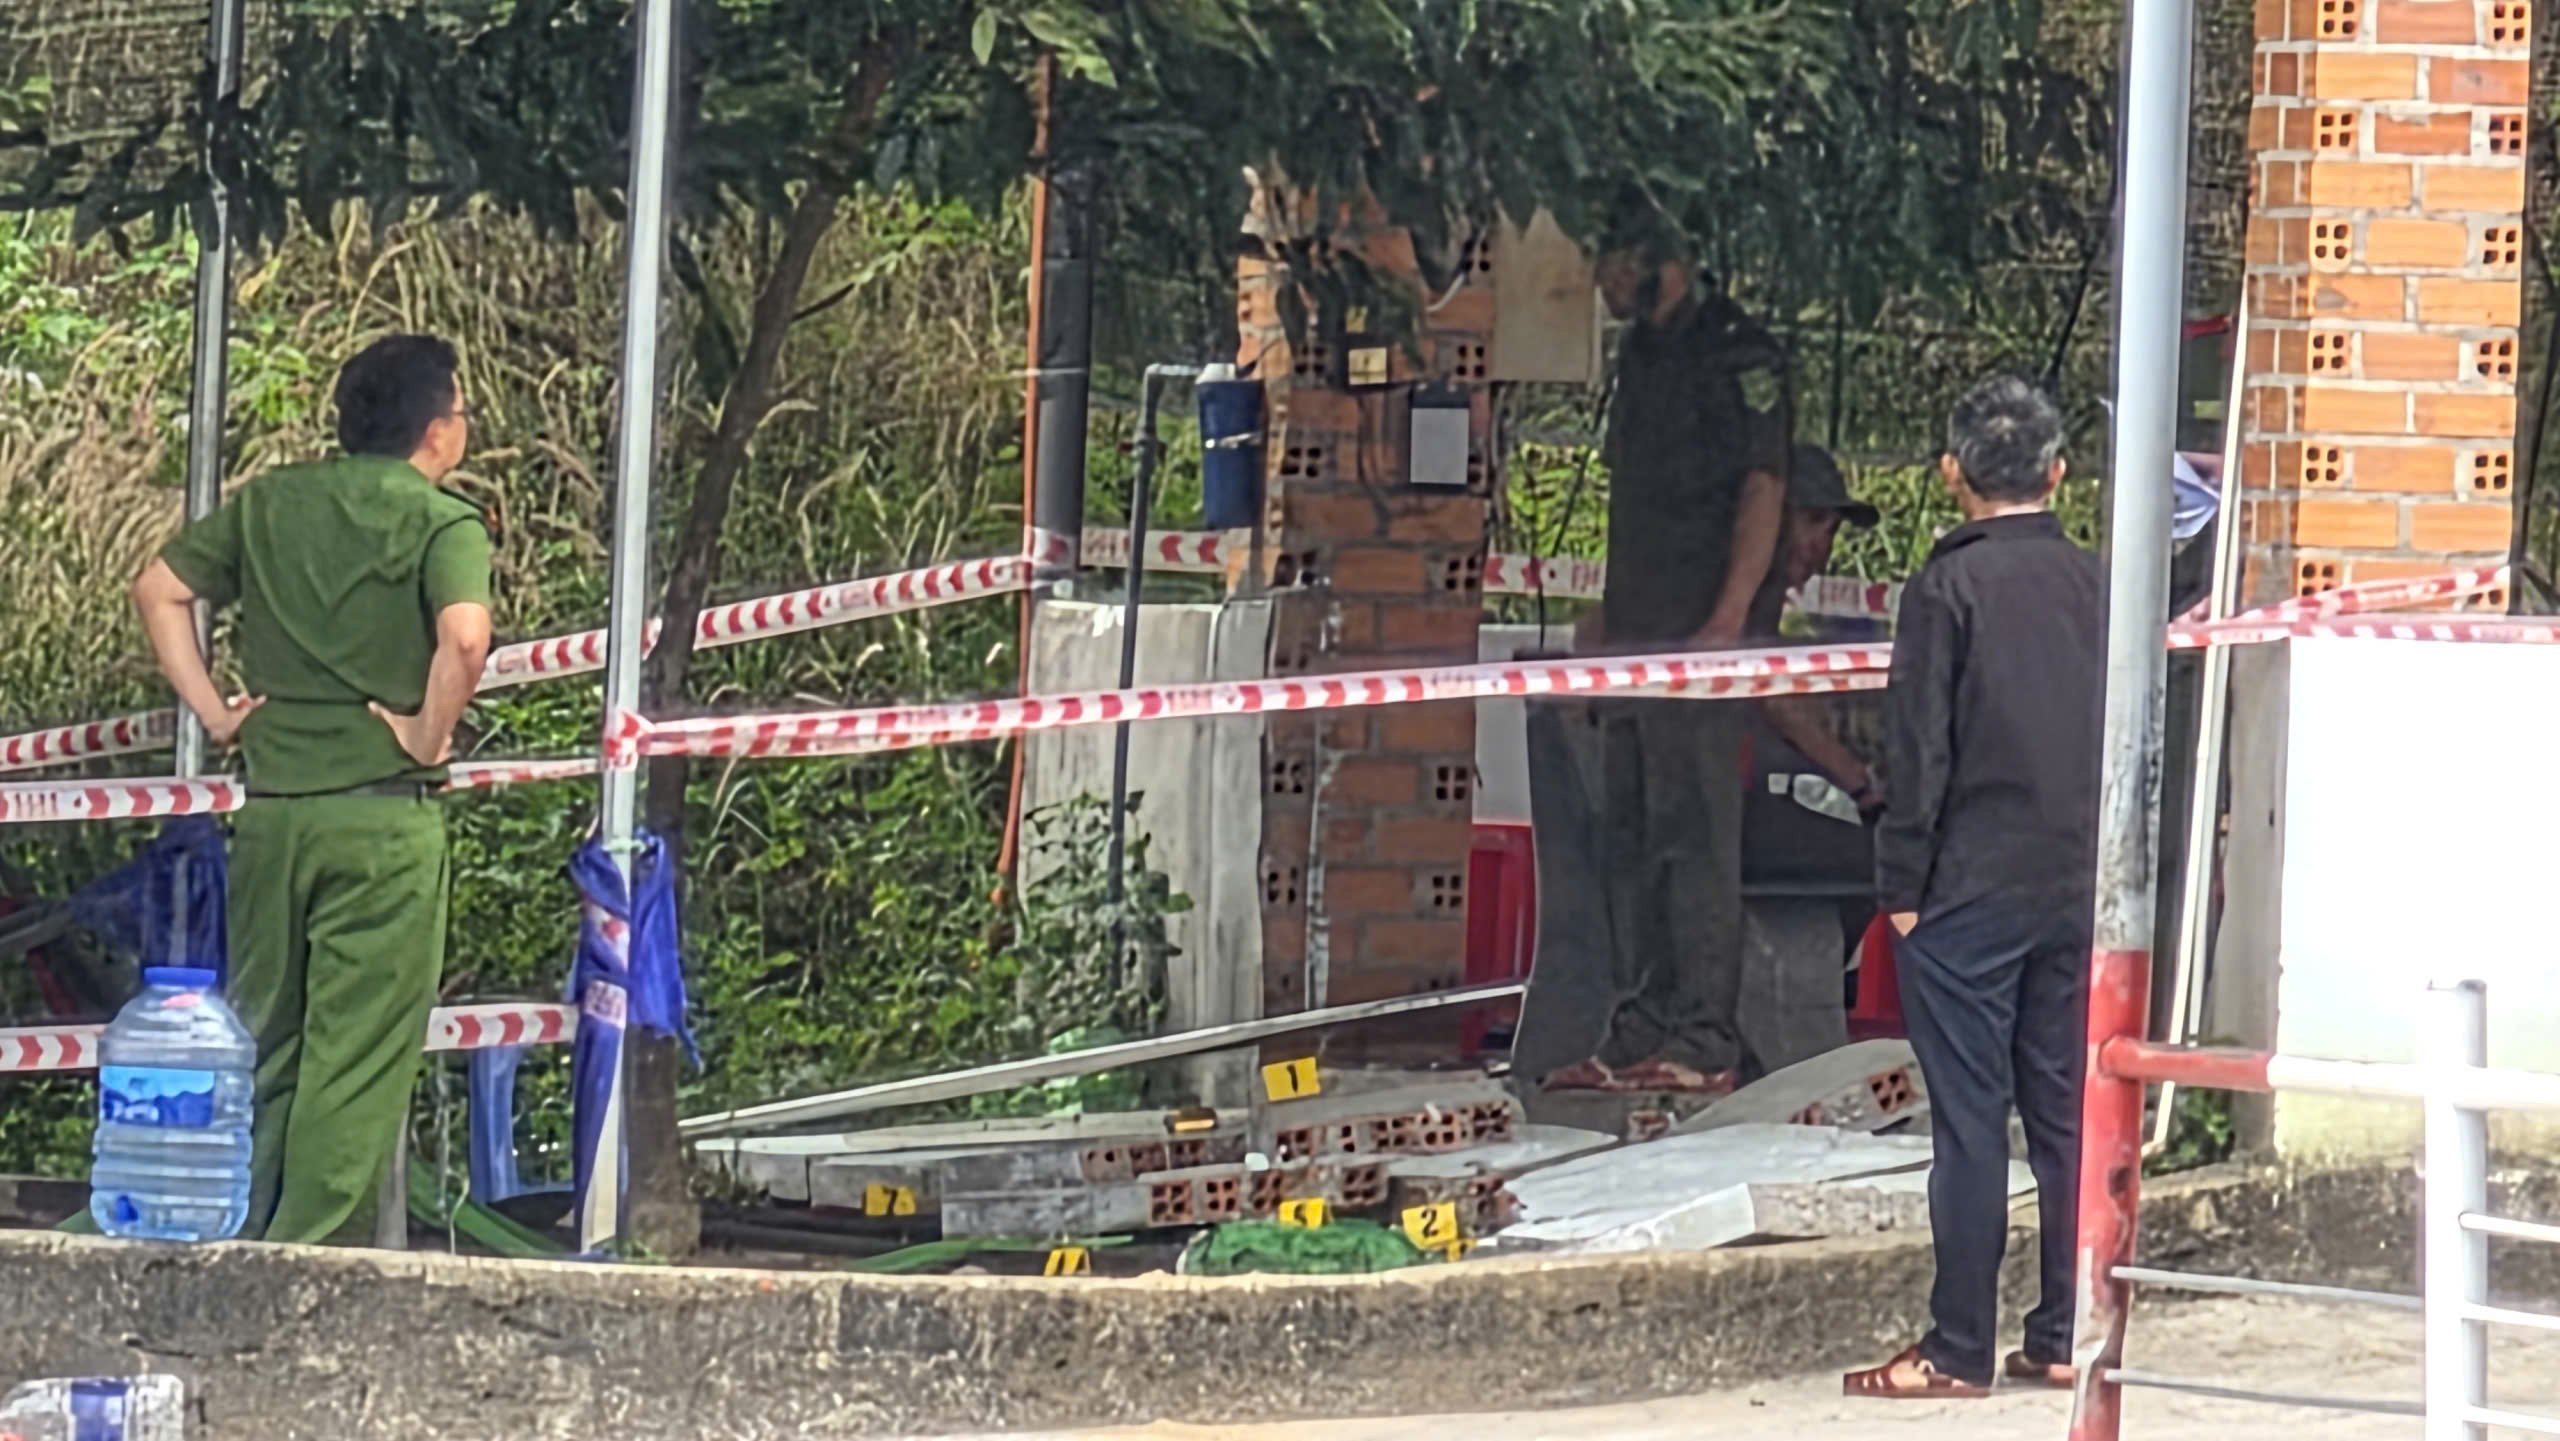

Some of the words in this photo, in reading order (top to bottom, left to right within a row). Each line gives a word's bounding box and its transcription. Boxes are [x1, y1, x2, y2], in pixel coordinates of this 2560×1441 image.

[1286, 1064, 1298, 1093] 1
[881, 1185, 898, 1216] 7
[1420, 1207, 1439, 1238] 2
